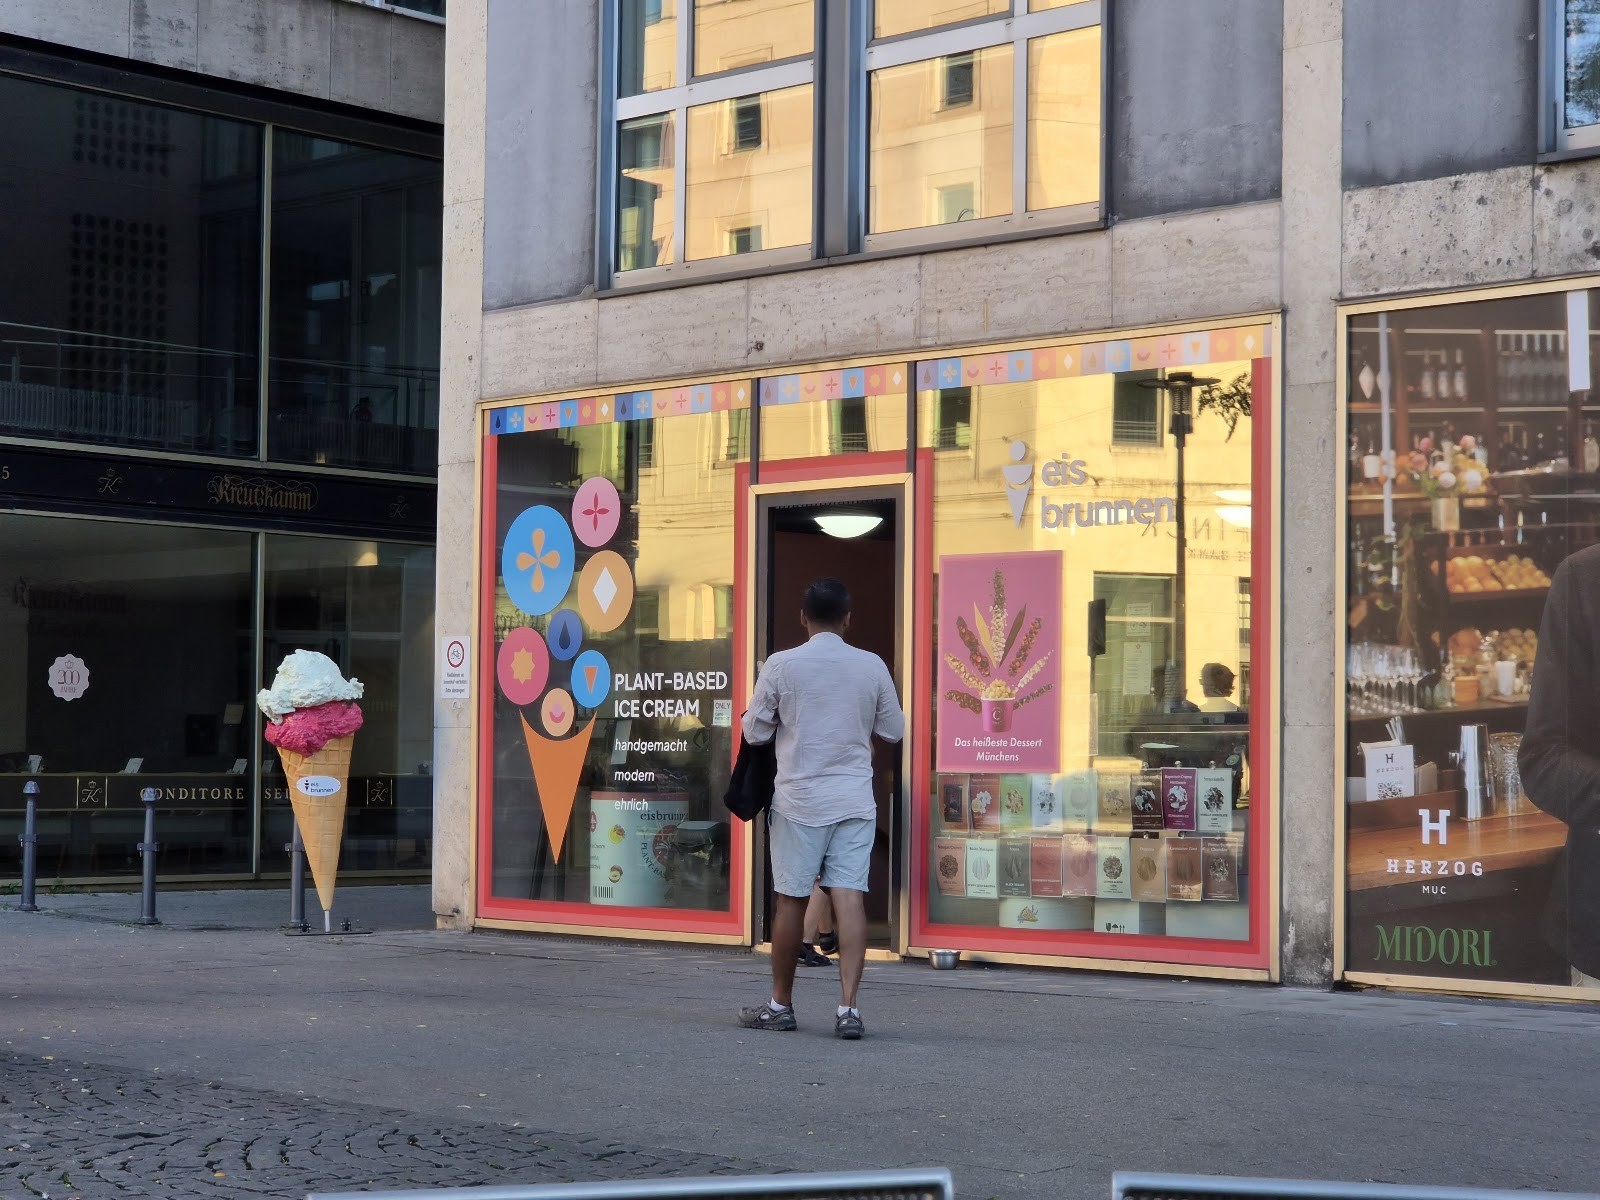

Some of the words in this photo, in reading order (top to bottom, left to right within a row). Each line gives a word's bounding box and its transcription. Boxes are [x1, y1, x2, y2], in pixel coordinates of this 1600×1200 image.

[1041, 453, 1087, 487] eis
[1041, 495, 1176, 529] brunnen
[57, 669, 81, 686] 200
[614, 671, 728, 692] PLANT-BASED
[614, 699, 640, 718] ICE
[642, 699, 700, 718] CREAM
[614, 739, 688, 754] handgemacht
[954, 738, 971, 747] Das
[972, 737, 1008, 747] heißeste
[1010, 737, 1043, 747] Dessert
[976, 751, 1020, 762] Münchens
[614, 769, 655, 782] modern
[614, 798, 649, 811] ehrlich
[1418, 808, 1451, 845] H
[1386, 859, 1484, 877] HERZOG
[1422, 885, 1447, 895] MUC
[1374, 924, 1493, 966] MIDORI
